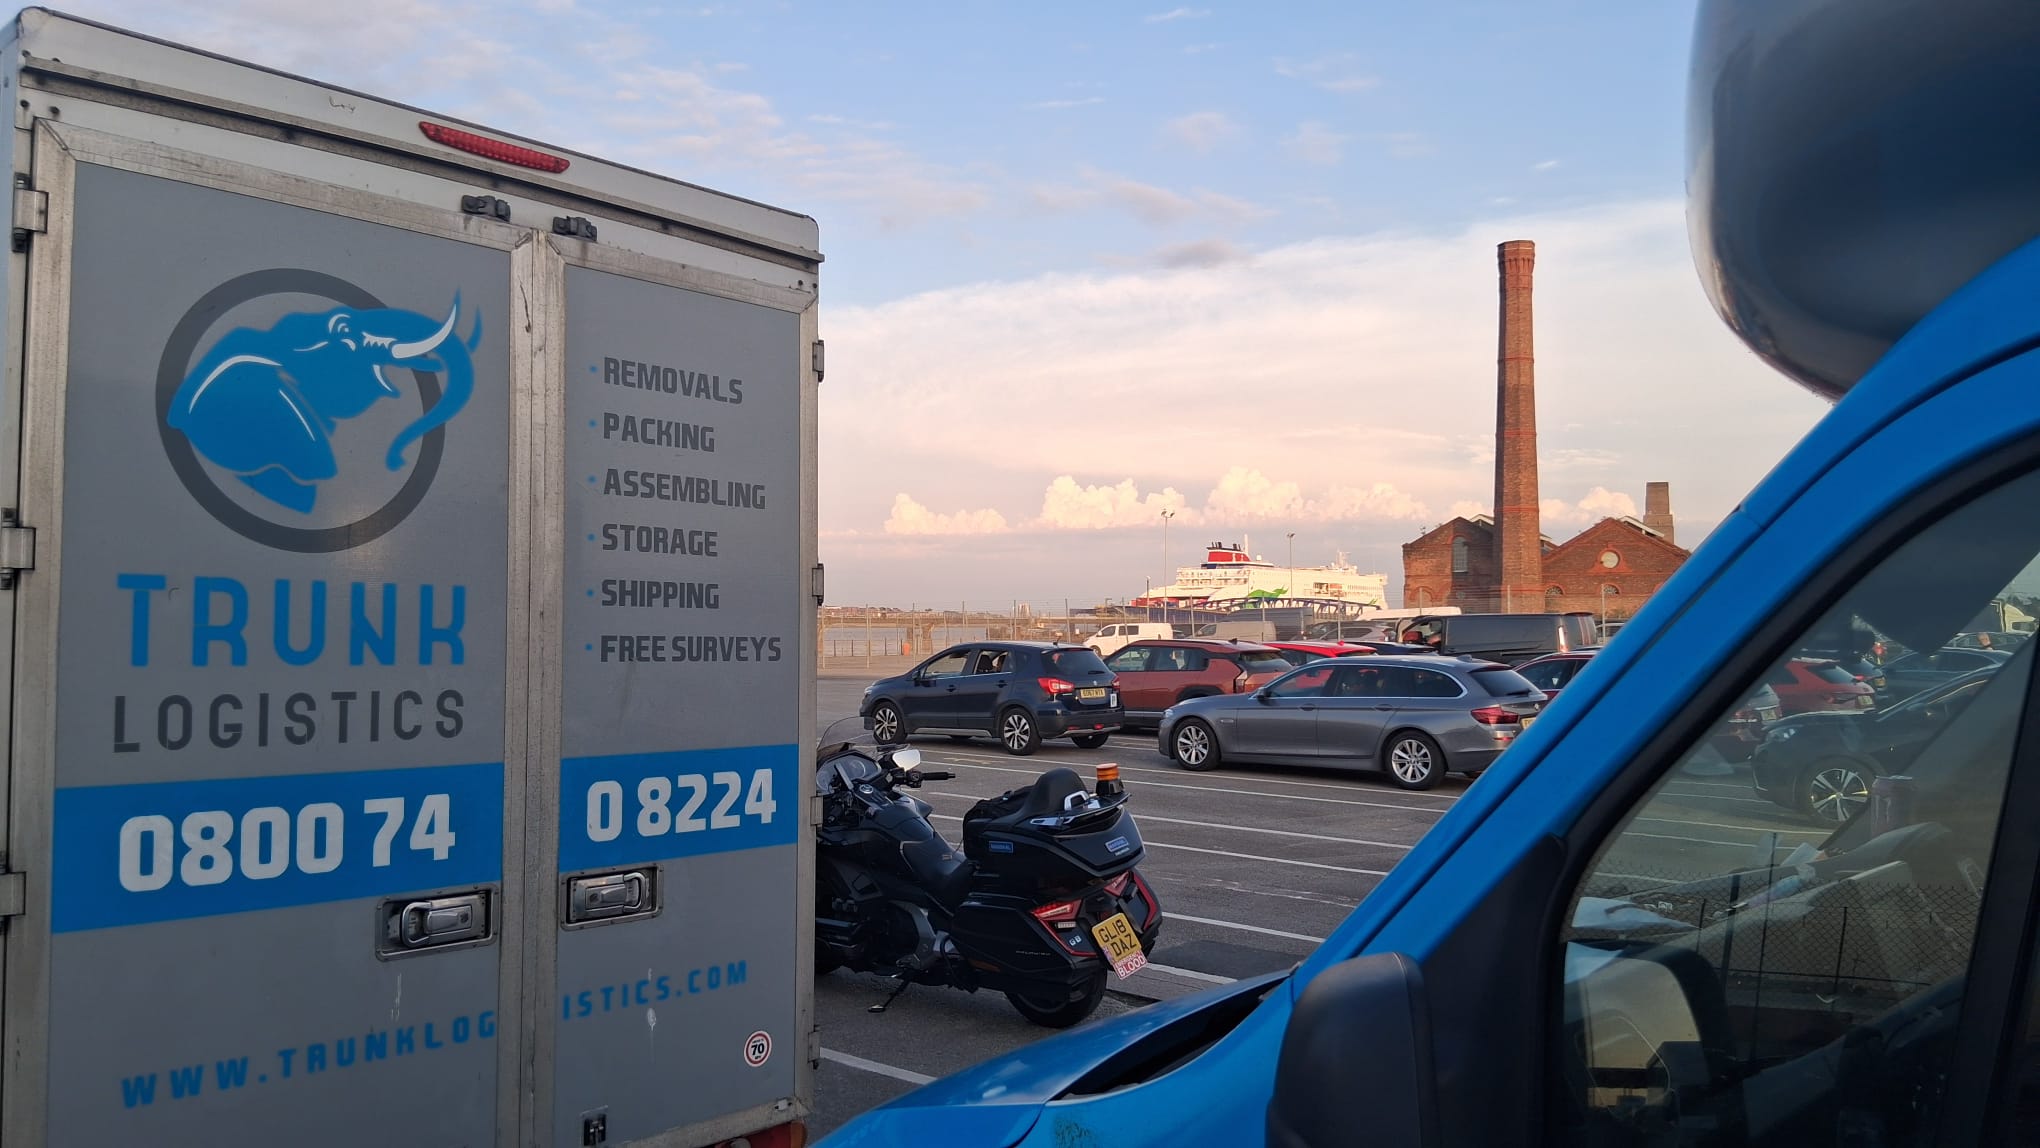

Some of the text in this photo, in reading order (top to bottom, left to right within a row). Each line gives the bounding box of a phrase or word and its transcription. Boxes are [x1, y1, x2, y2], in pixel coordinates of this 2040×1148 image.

[604, 357, 743, 404] REMOVALS
[603, 412, 715, 452] PACKING
[603, 468, 766, 509] ASSEMBLING
[602, 523, 718, 557] STORAGE
[601, 579, 720, 609] SHIPPING
[116, 572, 467, 668] TRUNK
[600, 634, 782, 663] FREE SURVEYS
[113, 689, 465, 753] LOGISTICS
[118, 801, 345, 893] 0800
[363, 793, 456, 868] 74
[1069, 935, 1082, 946] GB
[1110, 933, 1137, 957] DAZ
[1118, 955, 1146, 977] BLOOD
[751, 1042, 765, 1056] 70
